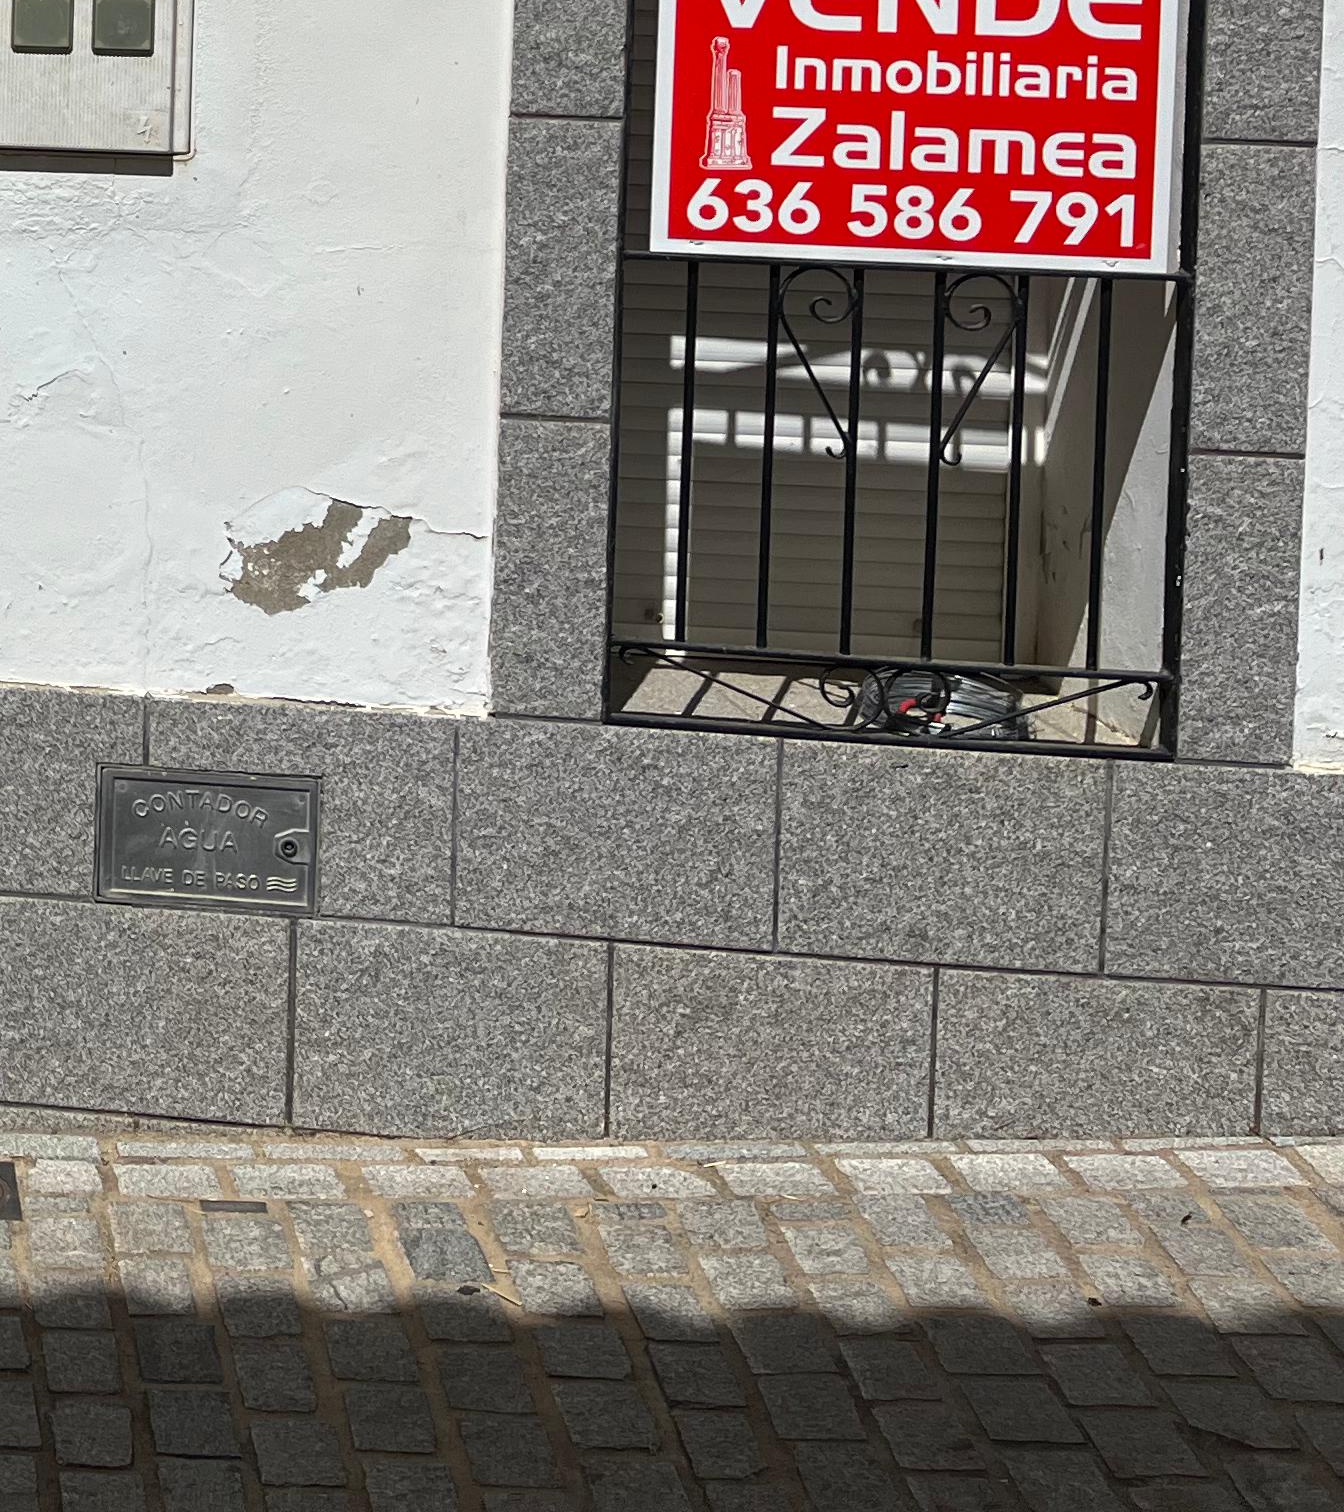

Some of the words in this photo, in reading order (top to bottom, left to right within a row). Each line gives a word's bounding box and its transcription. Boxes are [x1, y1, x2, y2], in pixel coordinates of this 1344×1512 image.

[775, 45, 1138, 101] Inmobiliaria
[770, 106, 1137, 179] Zalamea
[686, 178, 821, 235] 636
[846, 183, 982, 241] 586
[1009, 190, 1135, 248] 791
[131, 789, 270, 829] CONTADOR
[158, 825, 238, 854] AGUA
[120, 864, 174, 885] LLAVE
[181, 868, 206, 888] DE
[215, 871, 261, 890] PASO
